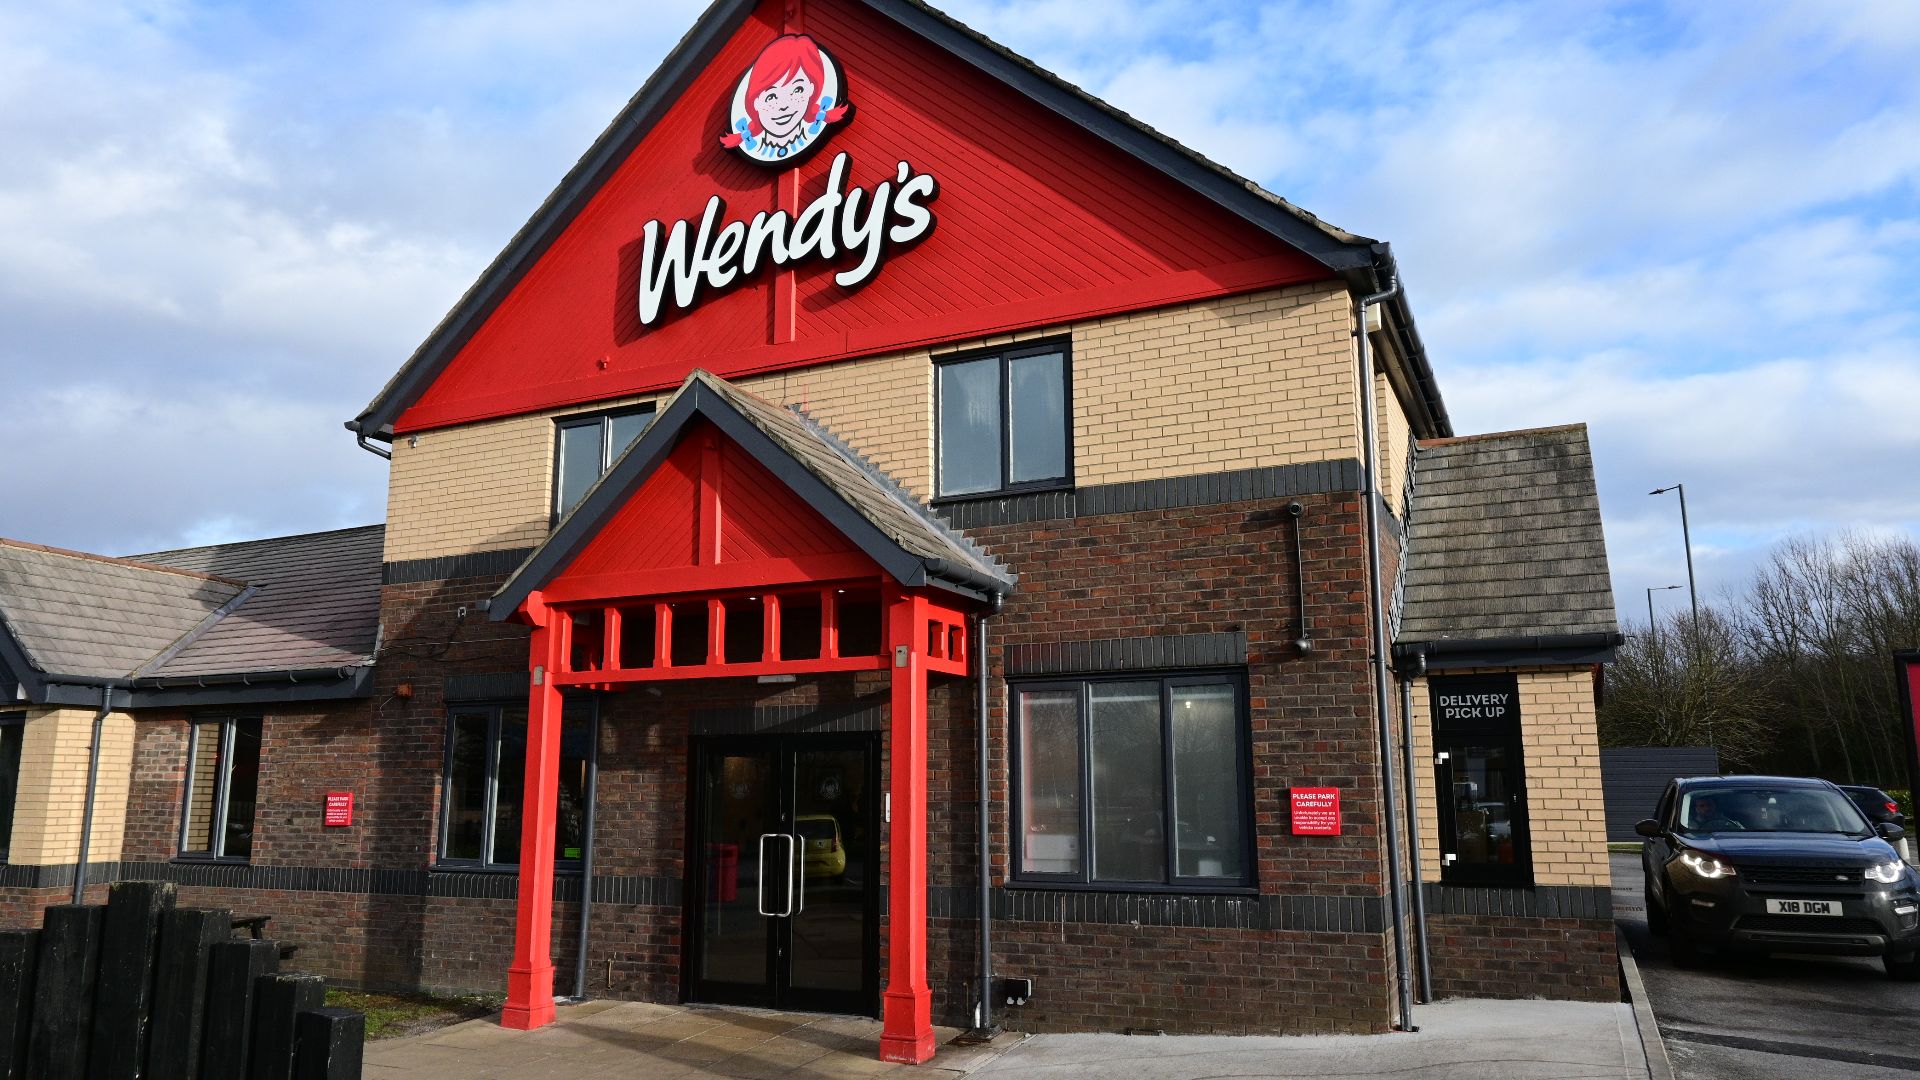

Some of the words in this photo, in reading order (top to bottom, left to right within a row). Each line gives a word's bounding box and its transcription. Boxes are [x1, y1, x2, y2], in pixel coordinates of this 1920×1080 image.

[639, 151, 935, 324] Wendy's
[1439, 693, 1509, 707] DELIVERY
[1445, 707, 1482, 719] PICK
[1486, 706, 1506, 718] UP
[1778, 901, 1800, 913] X18
[1803, 902, 1831, 914] DGM
